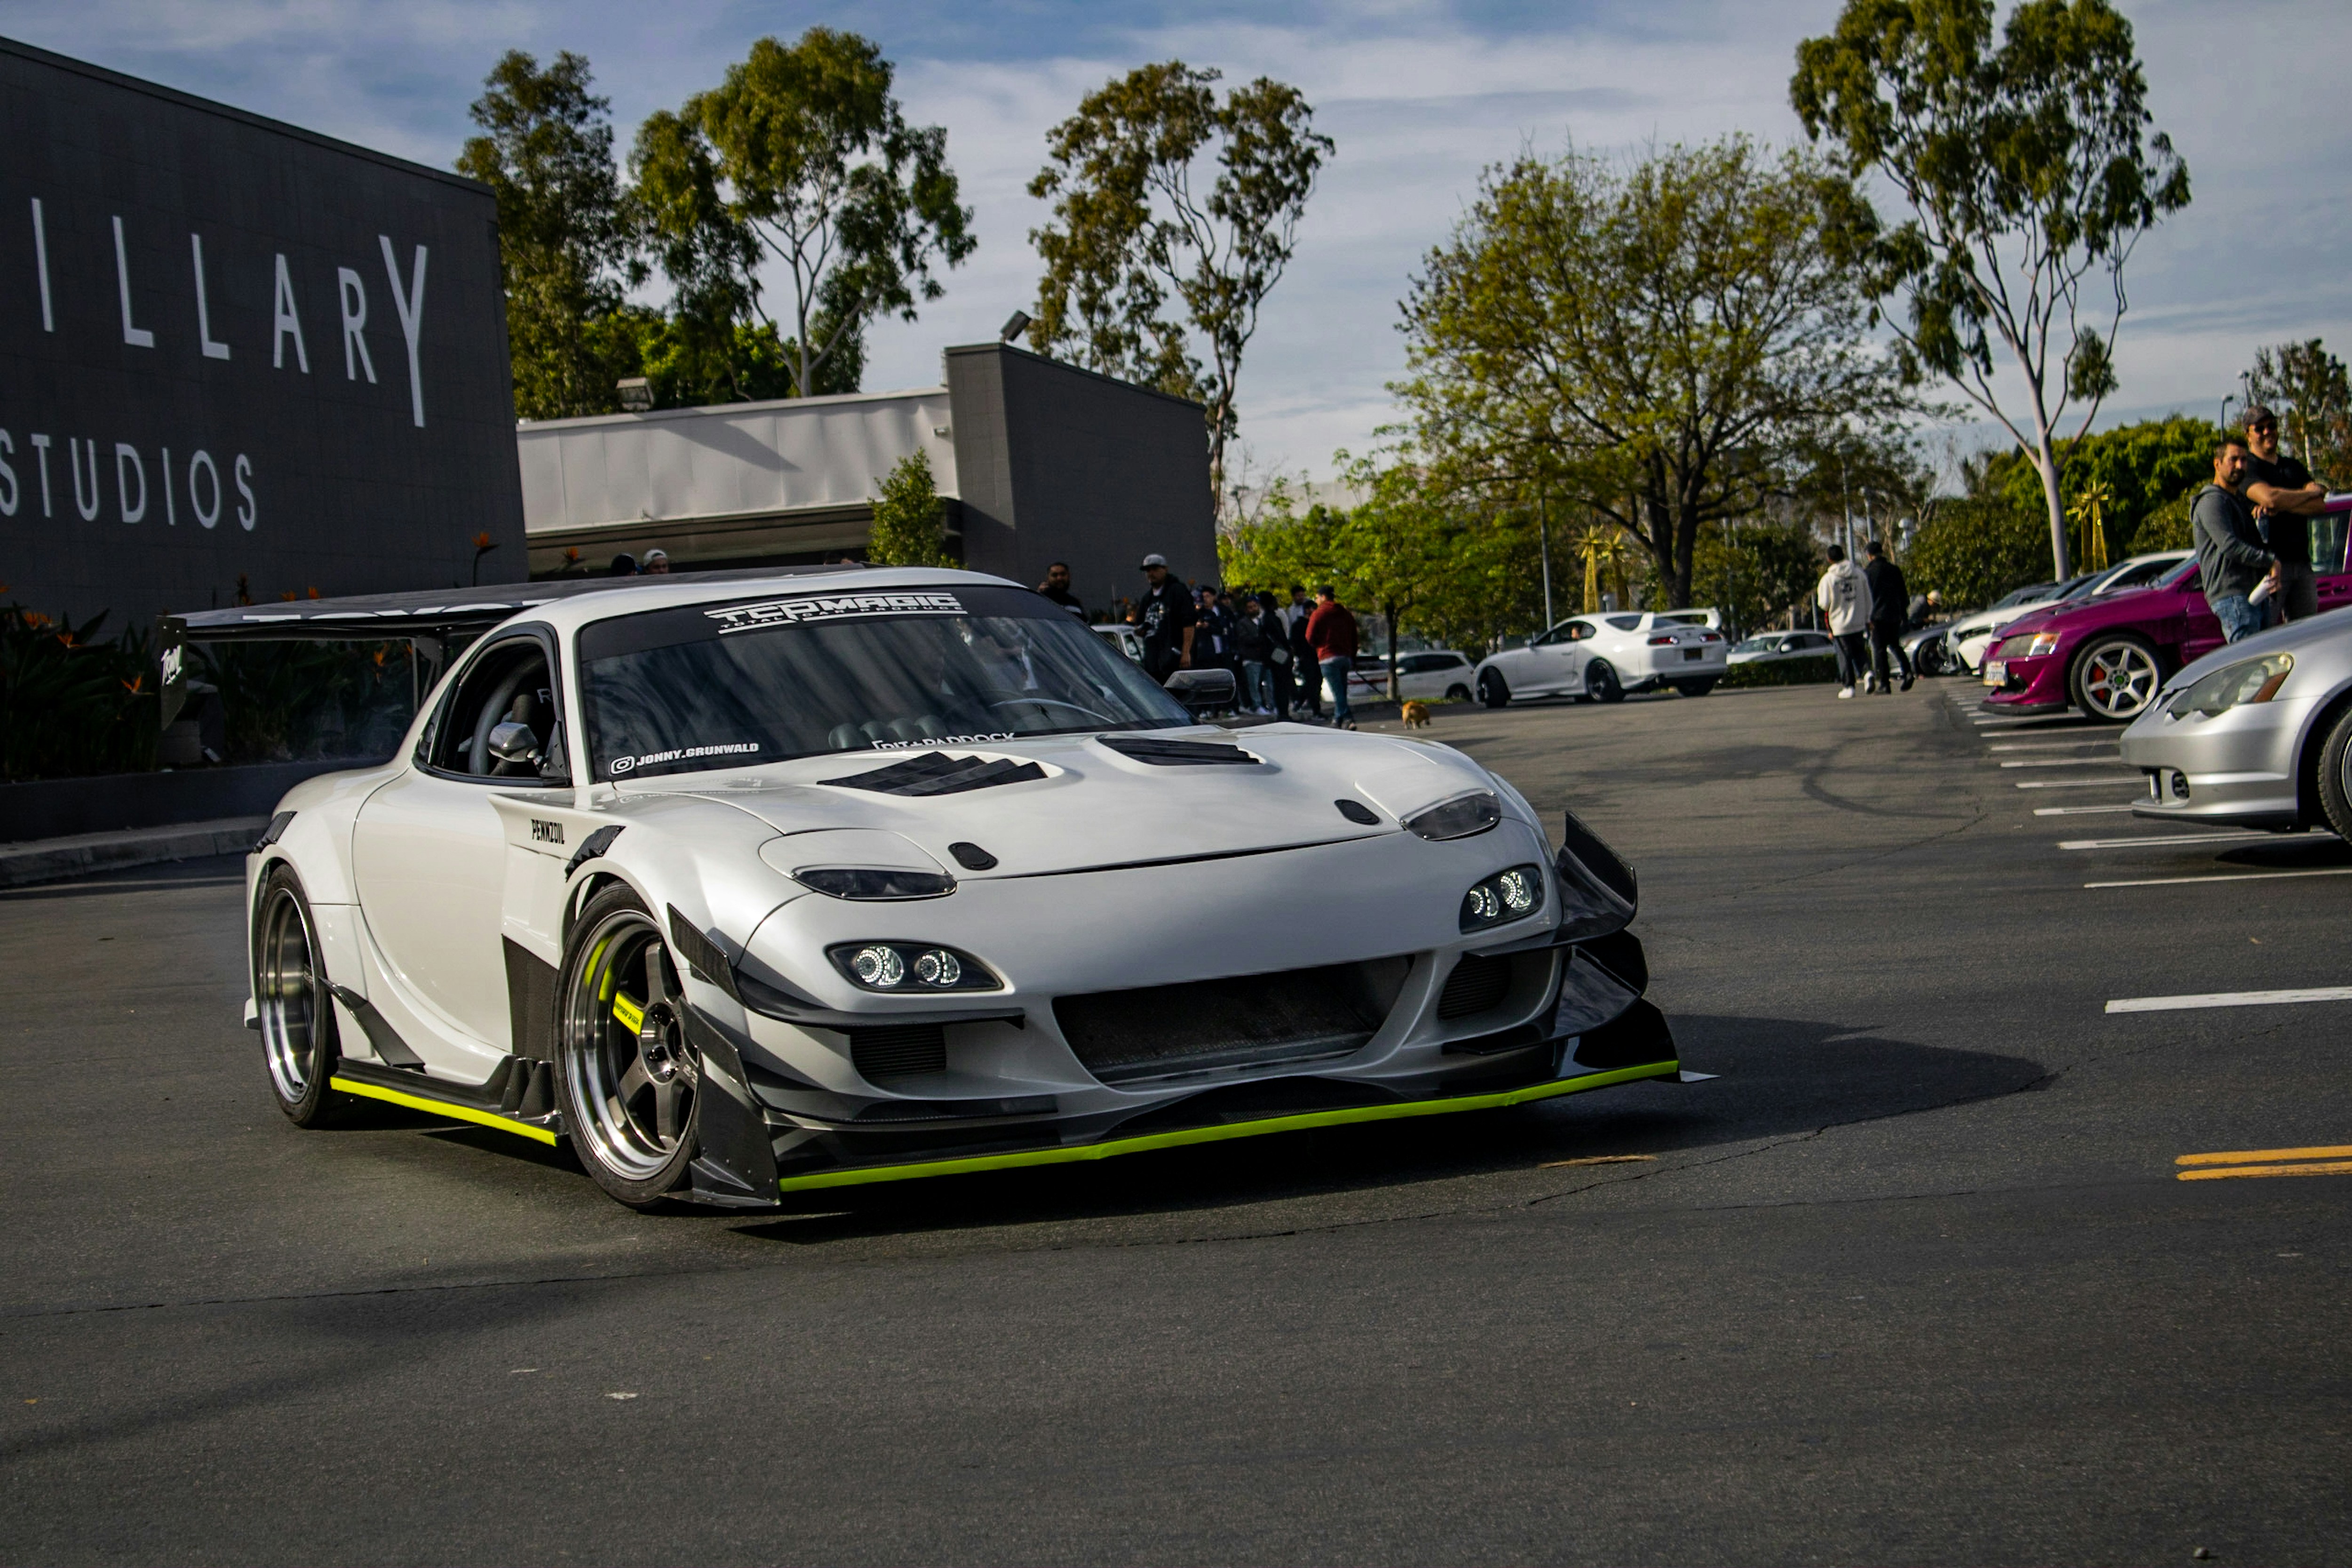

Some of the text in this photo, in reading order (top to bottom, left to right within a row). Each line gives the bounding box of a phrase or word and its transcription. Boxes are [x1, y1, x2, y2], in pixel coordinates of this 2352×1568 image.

[31, 197, 427, 428] ILLARY
[0, 428, 257, 531] STUDIOS
[720, 616, 783, 629] TOTAL
[636, 743, 759, 766] JONNY.GRUNWALD
[531, 819, 565, 844] PENNZOIL
